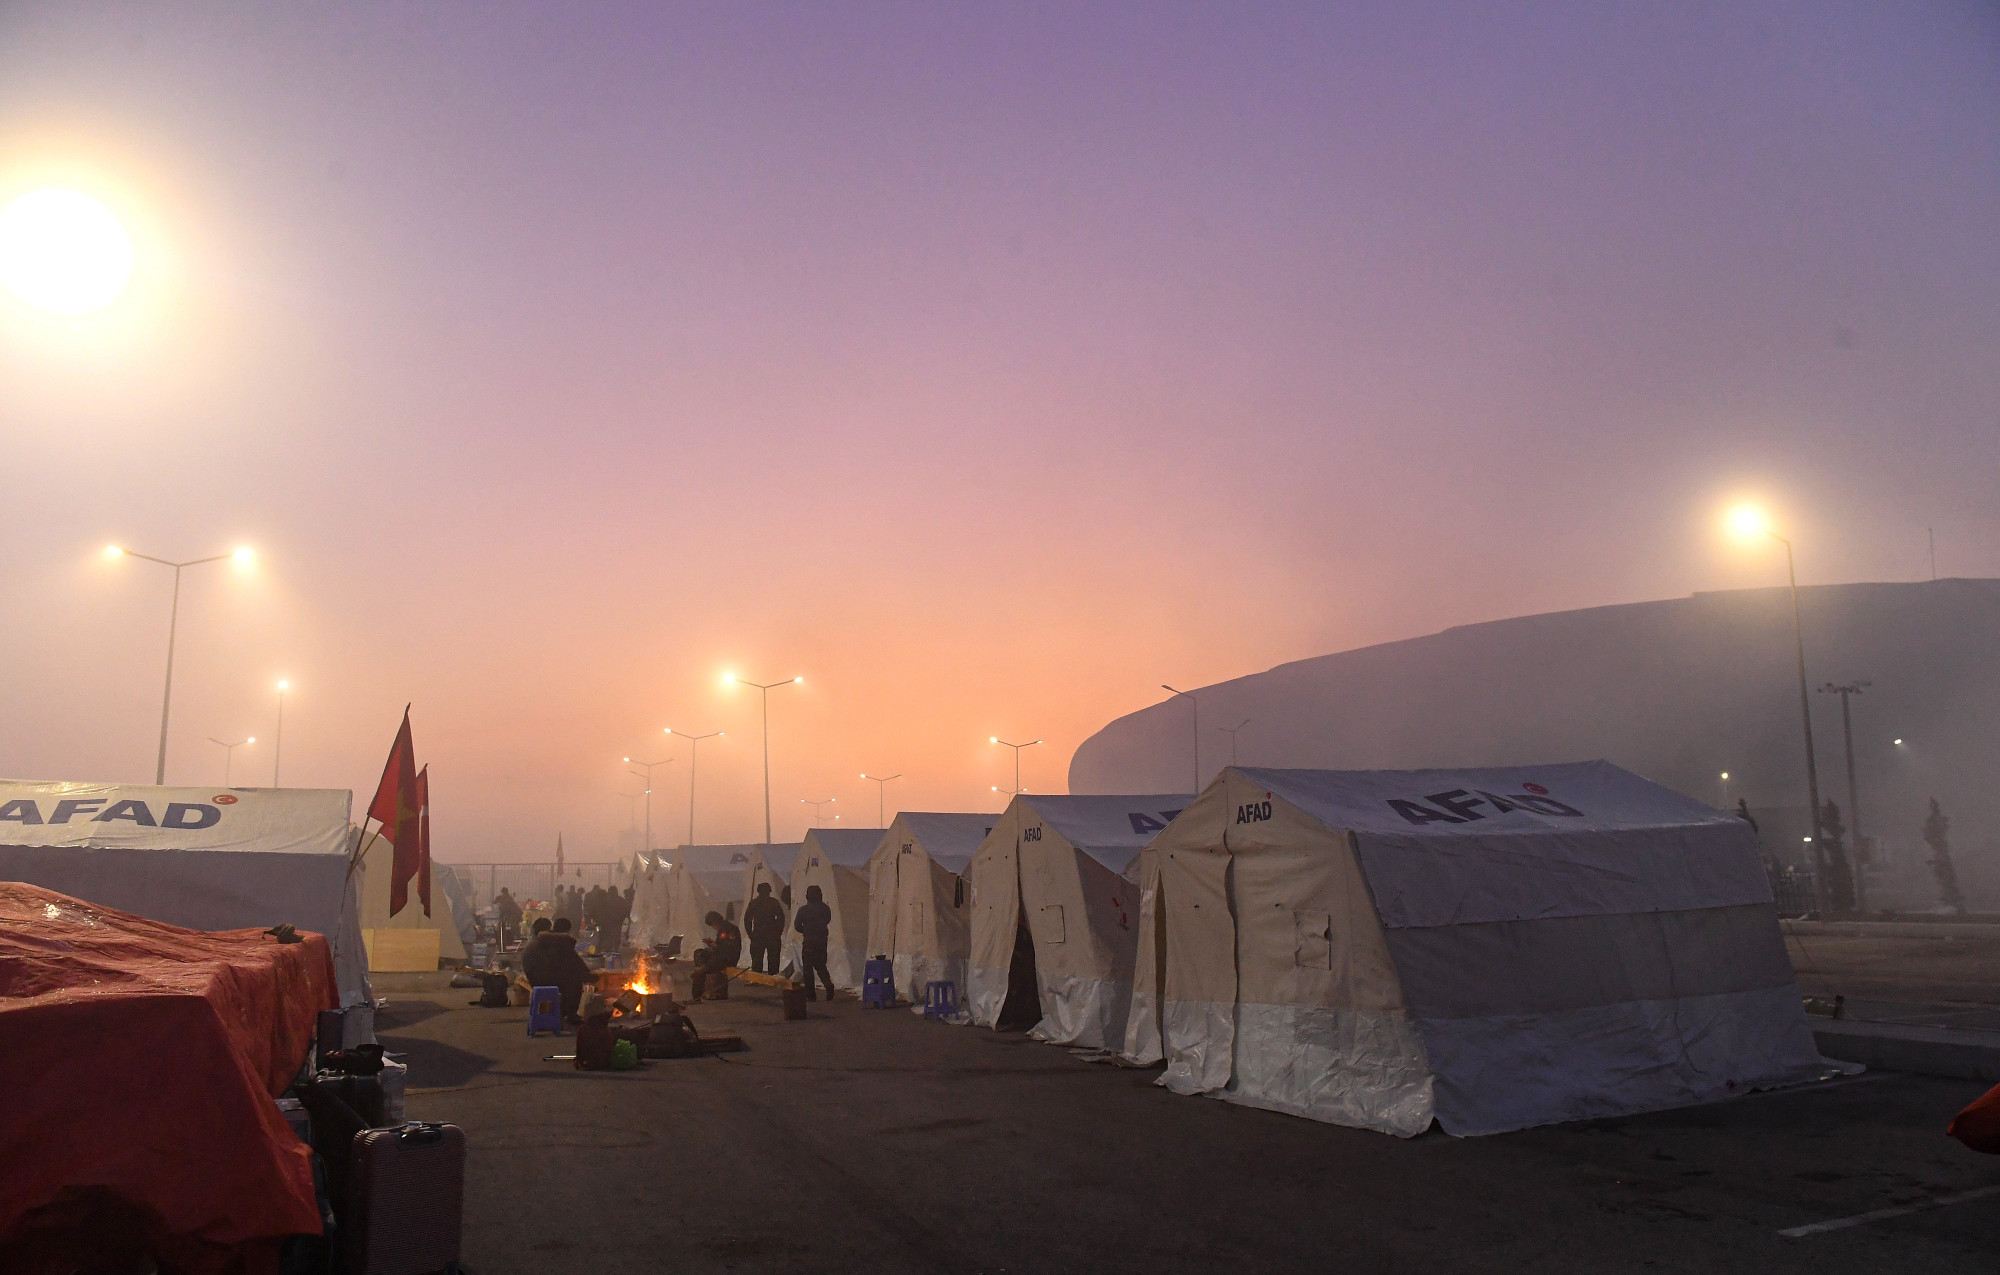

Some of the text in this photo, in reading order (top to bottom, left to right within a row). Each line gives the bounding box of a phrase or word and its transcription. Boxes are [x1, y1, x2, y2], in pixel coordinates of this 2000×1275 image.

[0, 798, 222, 829] AFAD
[1236, 802, 1272, 825] AFAD
[1386, 789, 1584, 825] AFAD
[1024, 827, 1041, 842] AFAD
